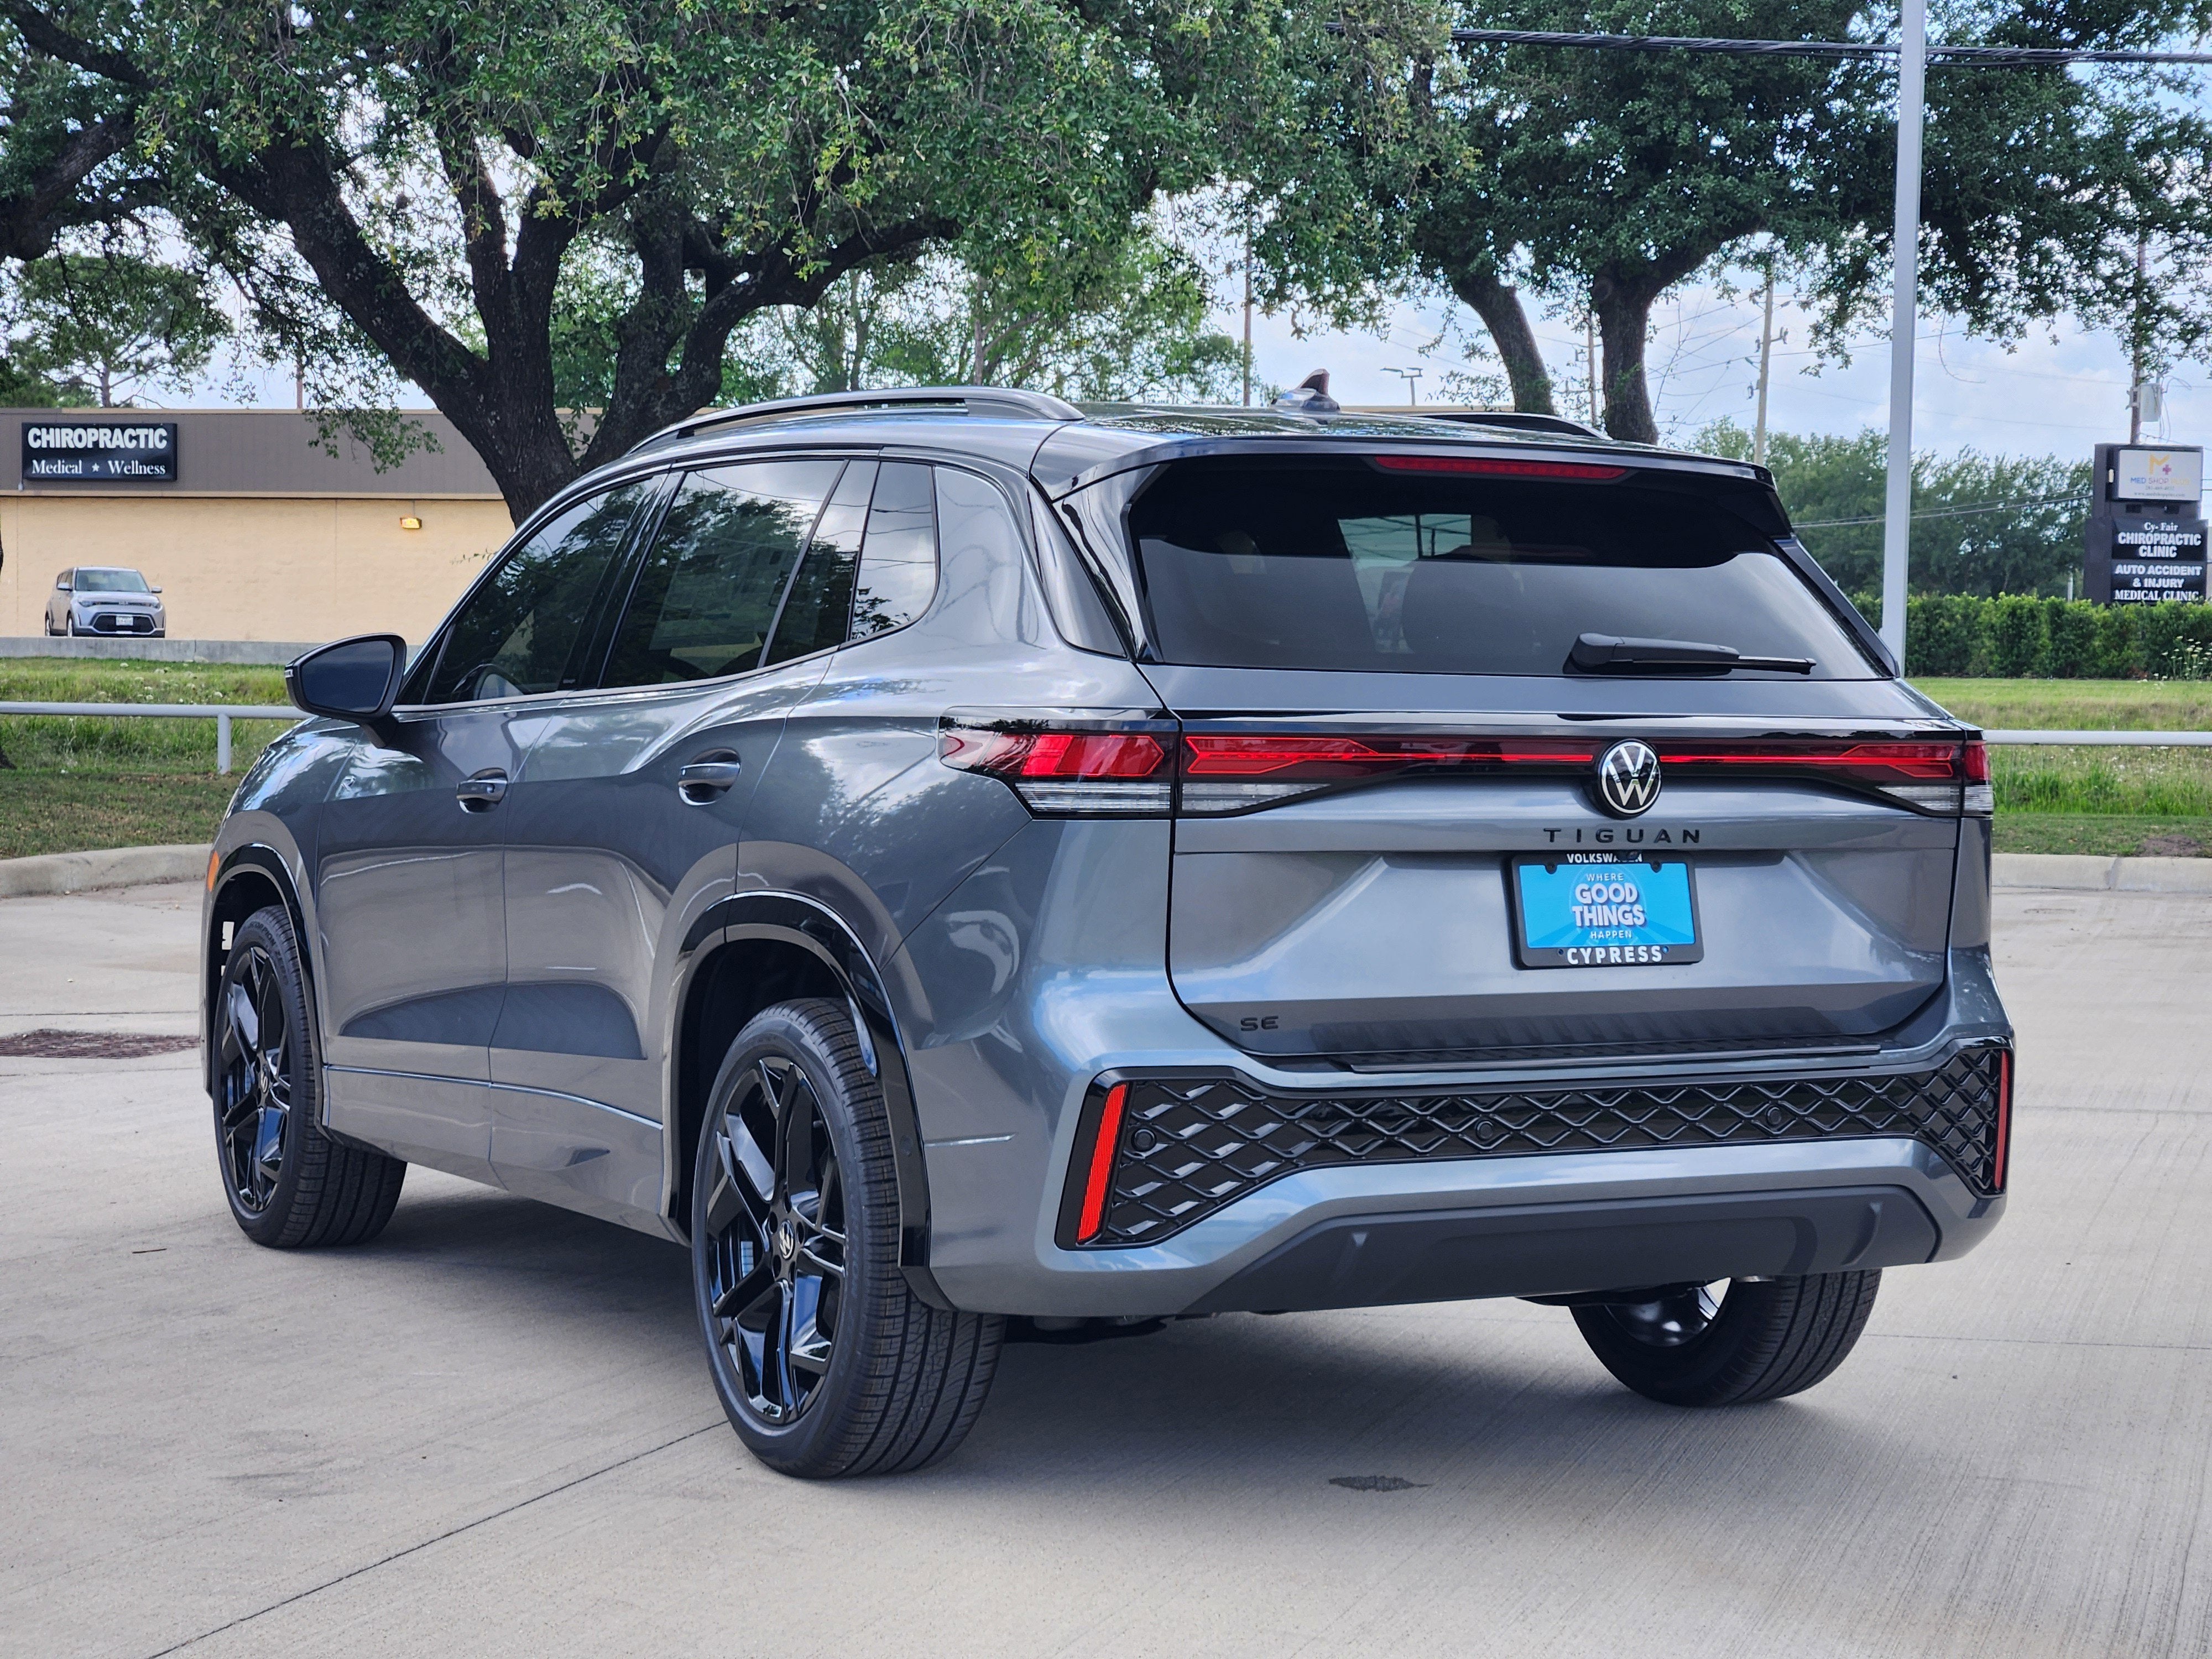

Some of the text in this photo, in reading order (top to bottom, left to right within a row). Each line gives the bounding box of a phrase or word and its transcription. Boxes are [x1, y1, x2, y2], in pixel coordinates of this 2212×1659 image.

[28, 427, 167, 449] CHIROPRACTIC
[32, 460, 166, 474] Medical Wellness
[2161, 522, 2178, 531] Fair
[2118, 532, 2202, 546] CHIROPRACTIC
[2138, 545, 2177, 557] CLINIC
[2115, 564, 2203, 576] AUTO ACCIDENT
[2132, 577, 2184, 588] & INJURY
[2114, 589, 2199, 601] MEDICAL CLINIC
[1543, 828, 1700, 843] TIGUAN
[1567, 853, 1642, 863] VOLKSWAN
[1586, 873, 1624, 881] WHERE
[1575, 883, 1639, 904] GOOD
[1572, 905, 1646, 927] THINGS
[1590, 930, 1632, 939] HAPPEN
[1567, 946, 1662, 964] CYPRESS
[1240, 1016, 1279, 1031] SE
